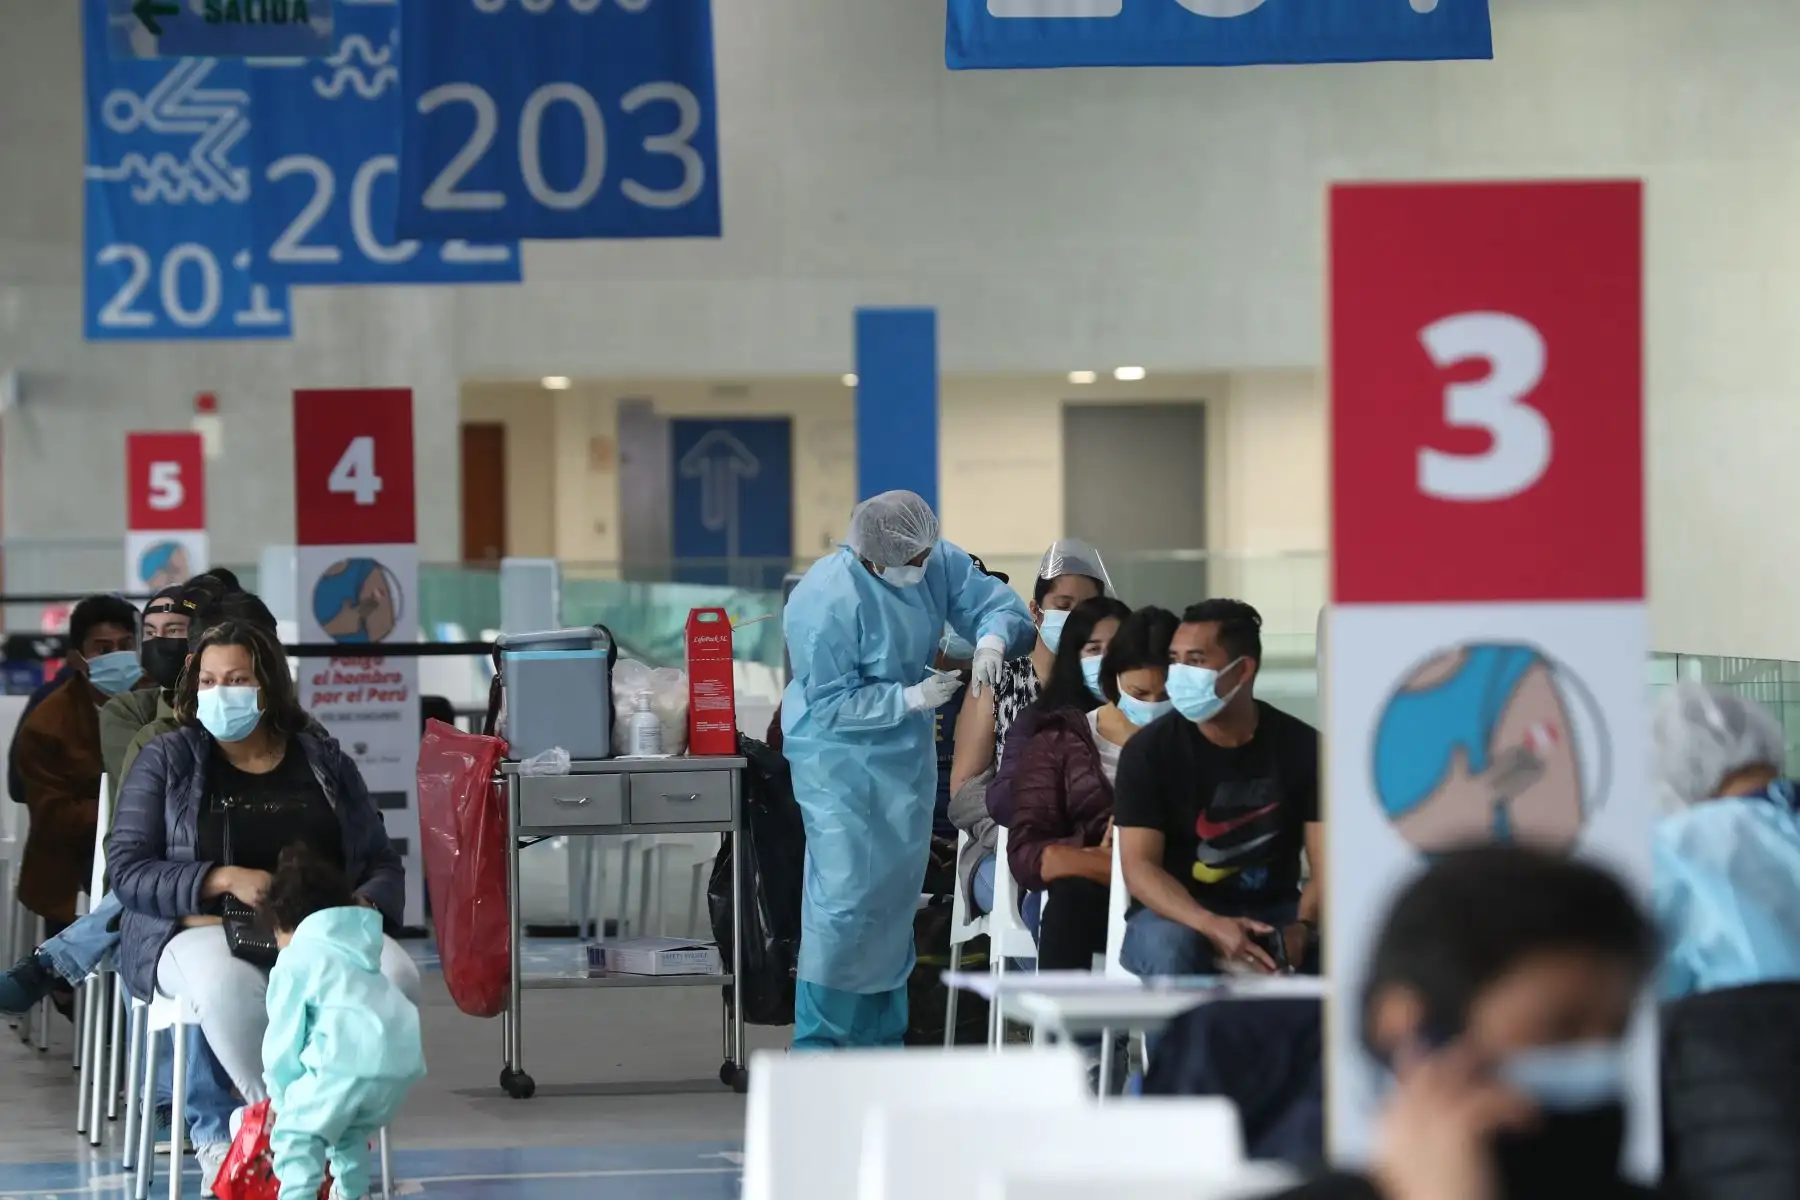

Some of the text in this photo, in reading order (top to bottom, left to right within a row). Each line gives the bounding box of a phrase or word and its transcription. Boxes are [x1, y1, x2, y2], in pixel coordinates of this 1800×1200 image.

[204, 0, 308, 25] SALIDA
[416, 82, 705, 209] 203
[266, 155, 510, 263] 20
[1417, 310, 1553, 502] 3
[148, 460, 184, 510] 5
[328, 436, 383, 505] 4
[311, 685, 408, 708] por el Perú
[333, 669, 403, 684] hombro
